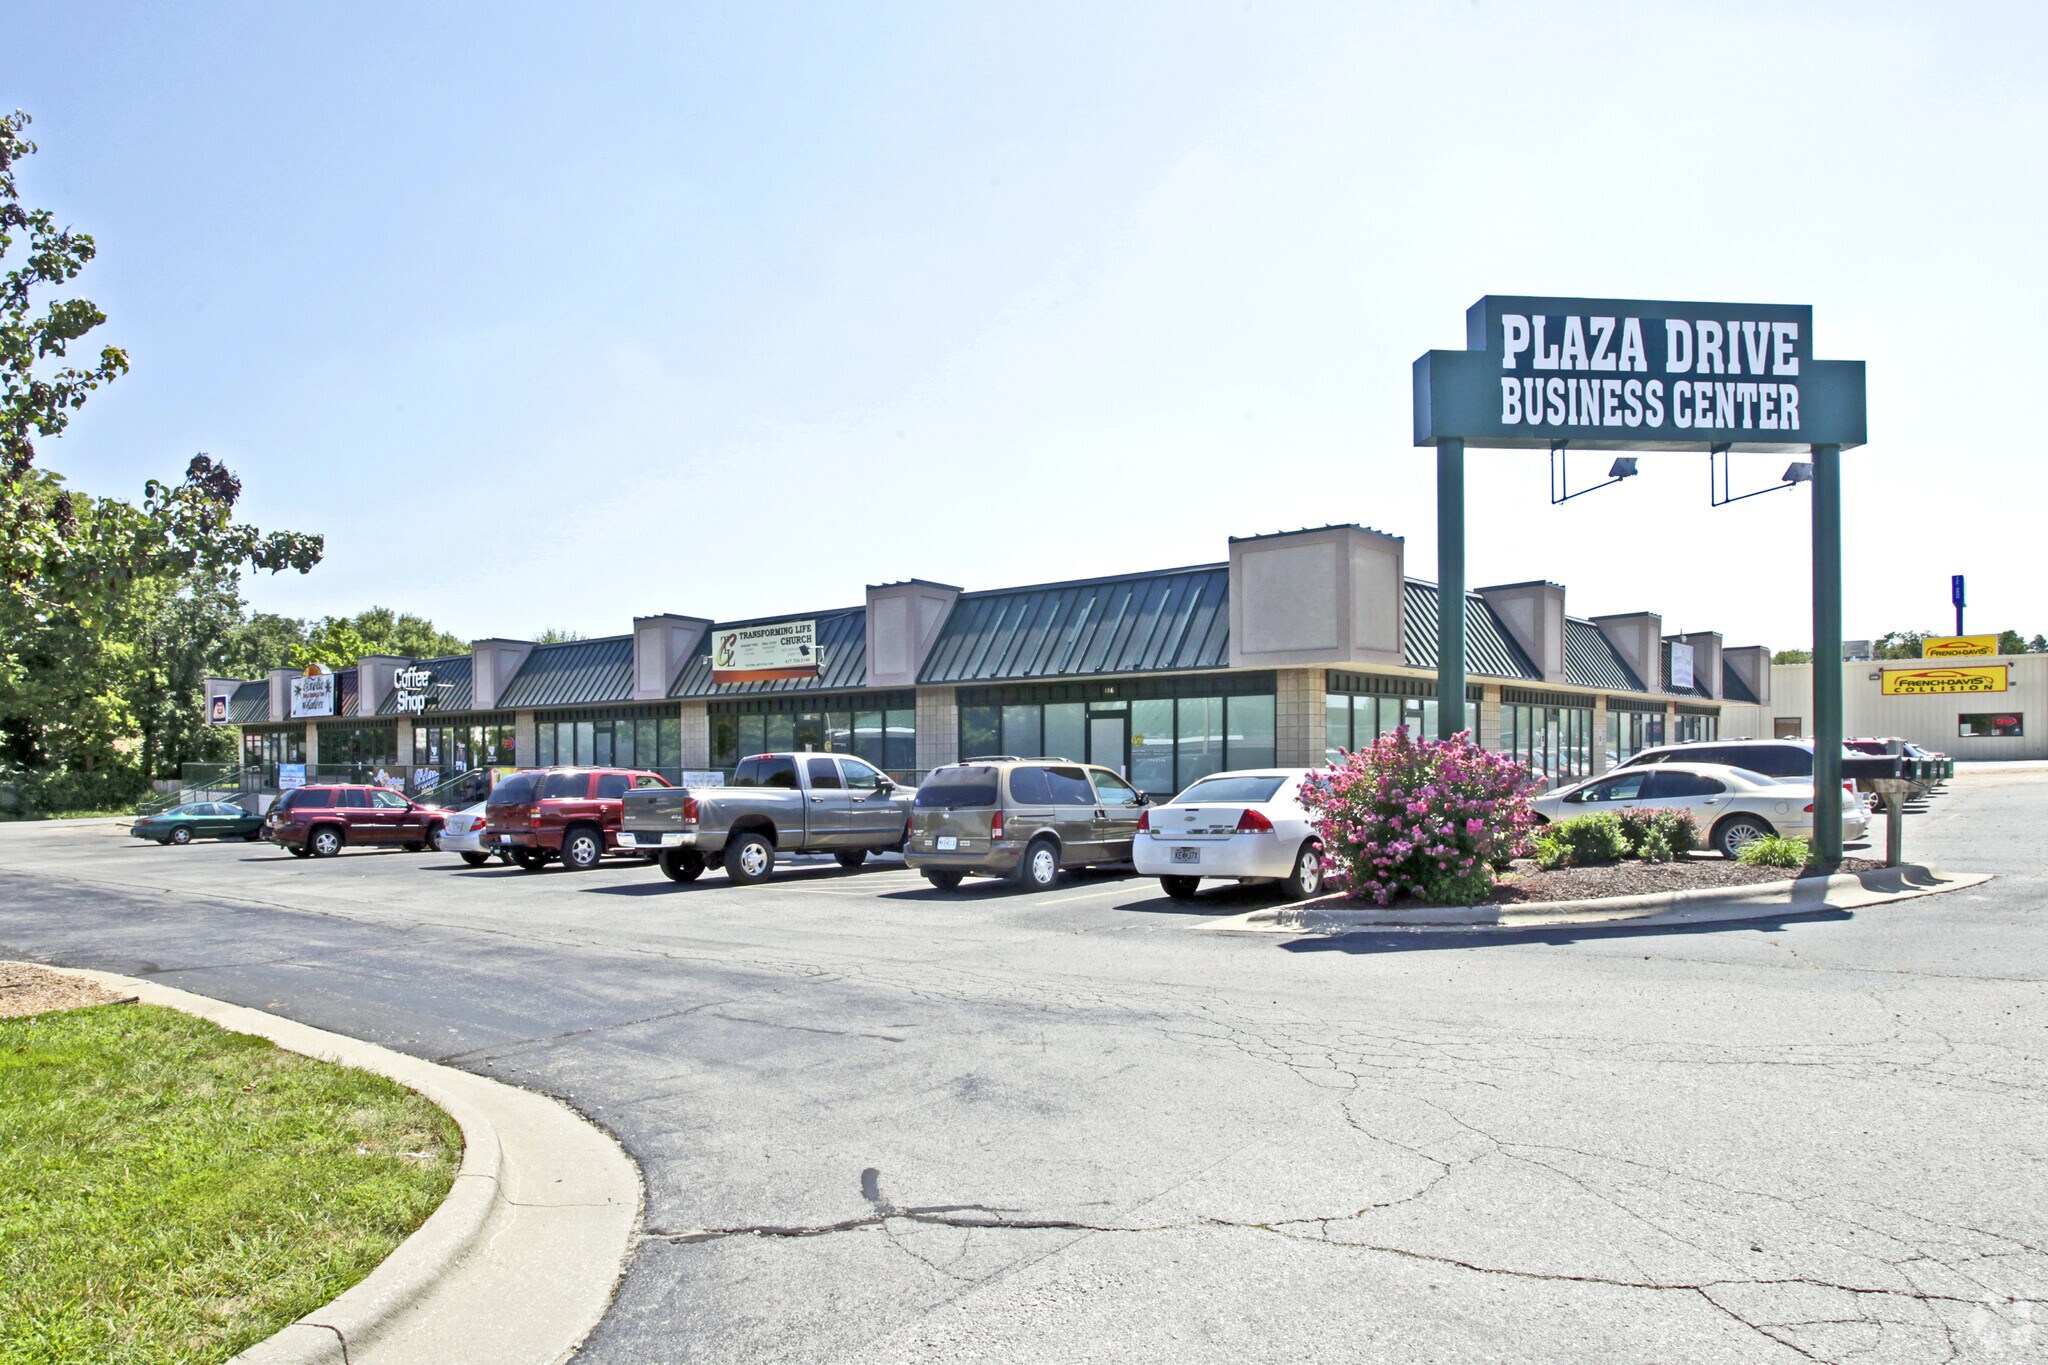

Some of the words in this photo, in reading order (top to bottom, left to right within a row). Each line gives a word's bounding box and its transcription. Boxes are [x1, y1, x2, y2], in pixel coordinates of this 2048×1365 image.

[1501, 314, 1648, 372] PLAZA
[1665, 318, 1799, 376] DRIVE
[1501, 376, 1664, 428] BUSINESS
[1673, 380, 1800, 430] CENTER
[739, 627, 794, 640] TRANSFORMING
[795, 624, 812, 634] LIFE
[781, 635, 812, 646] CHURCH
[1930, 648, 1988, 657] FRENCH-DAVIS
[394, 666, 430, 688] Coffee
[1900, 678, 1984, 687] FRENCH-DAVIS
[1894, 685, 1993, 693] COLLISION
[397, 690, 427, 715] Shop
